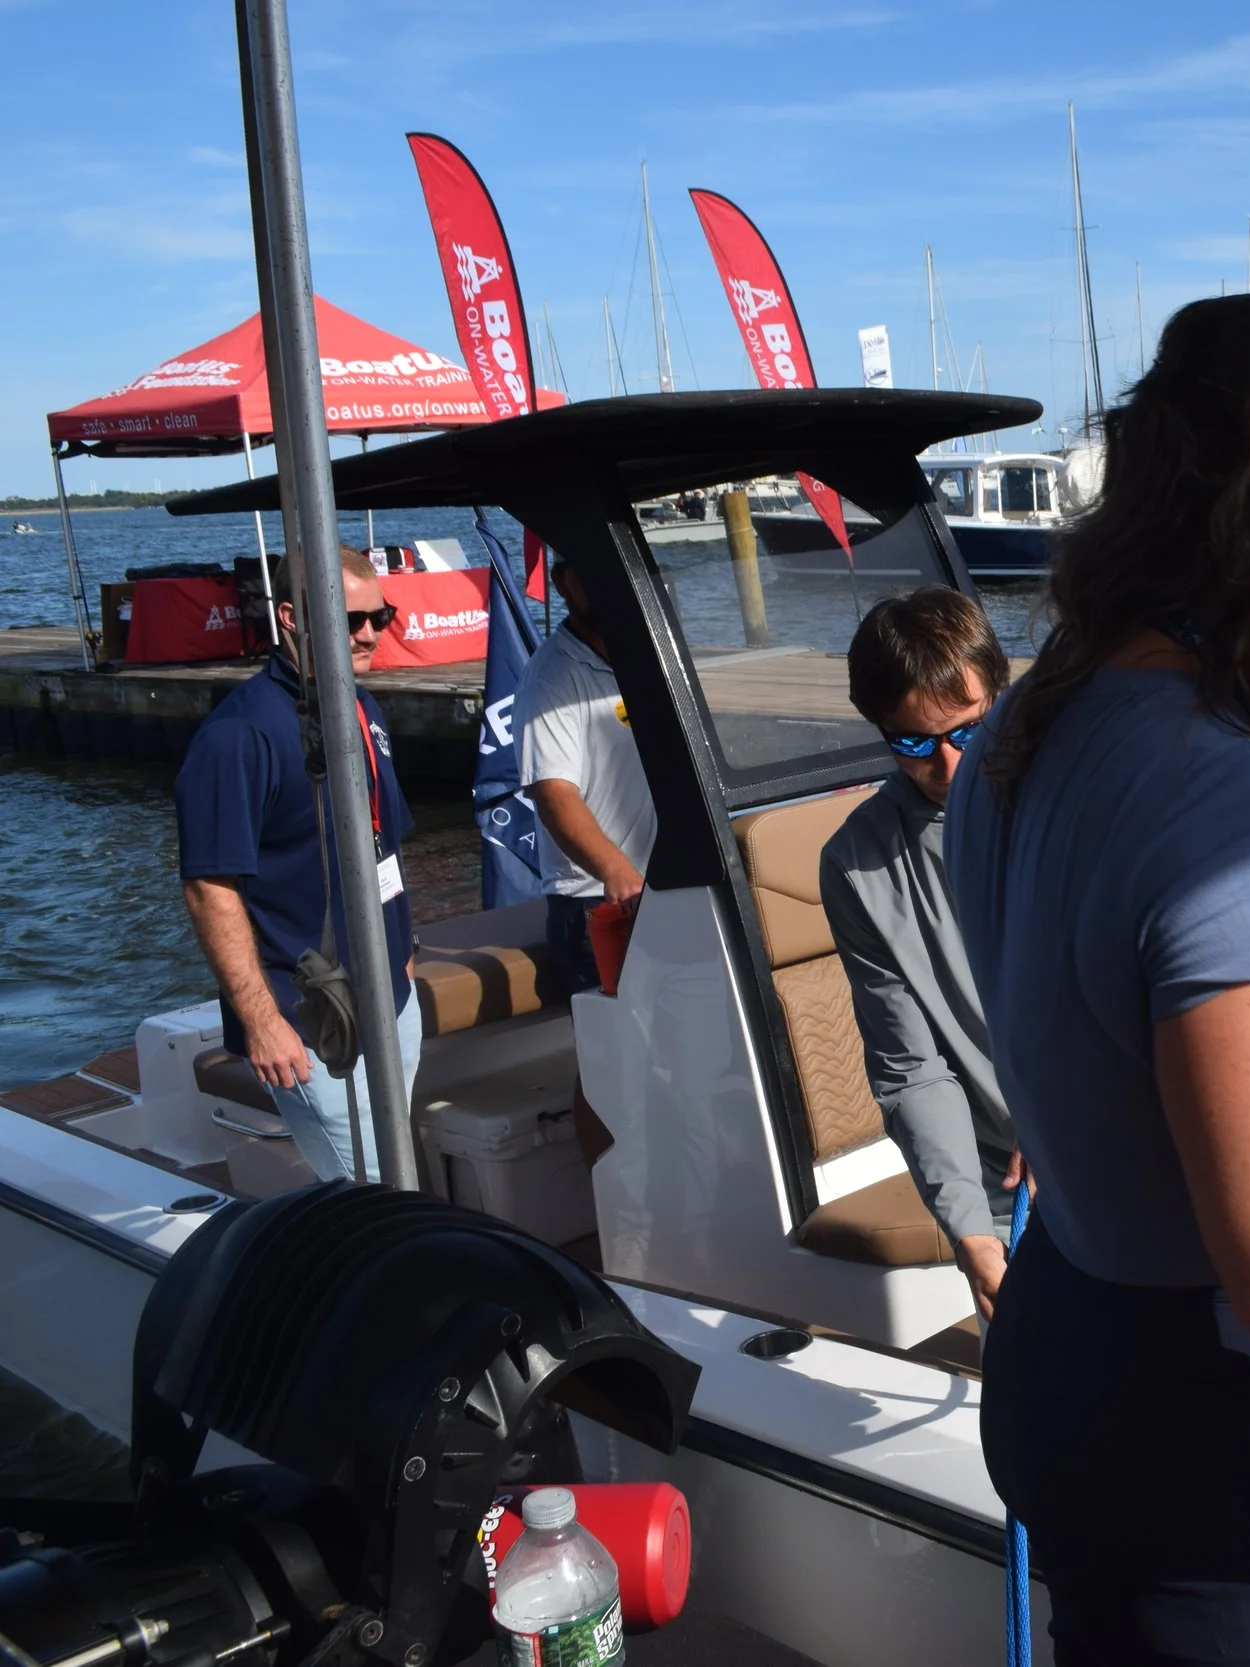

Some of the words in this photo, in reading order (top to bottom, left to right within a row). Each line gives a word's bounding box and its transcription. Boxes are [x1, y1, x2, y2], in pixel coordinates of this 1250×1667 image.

[466, 307, 513, 417] ON-WATER
[746, 328, 778, 389] ON-WA
[415, 370, 472, 388] TRAINI
[327, 399, 487, 421] oatus.org/onwat
[82, 419, 107, 435] safe
[119, 416, 152, 432] smart
[164, 412, 197, 429] clean
